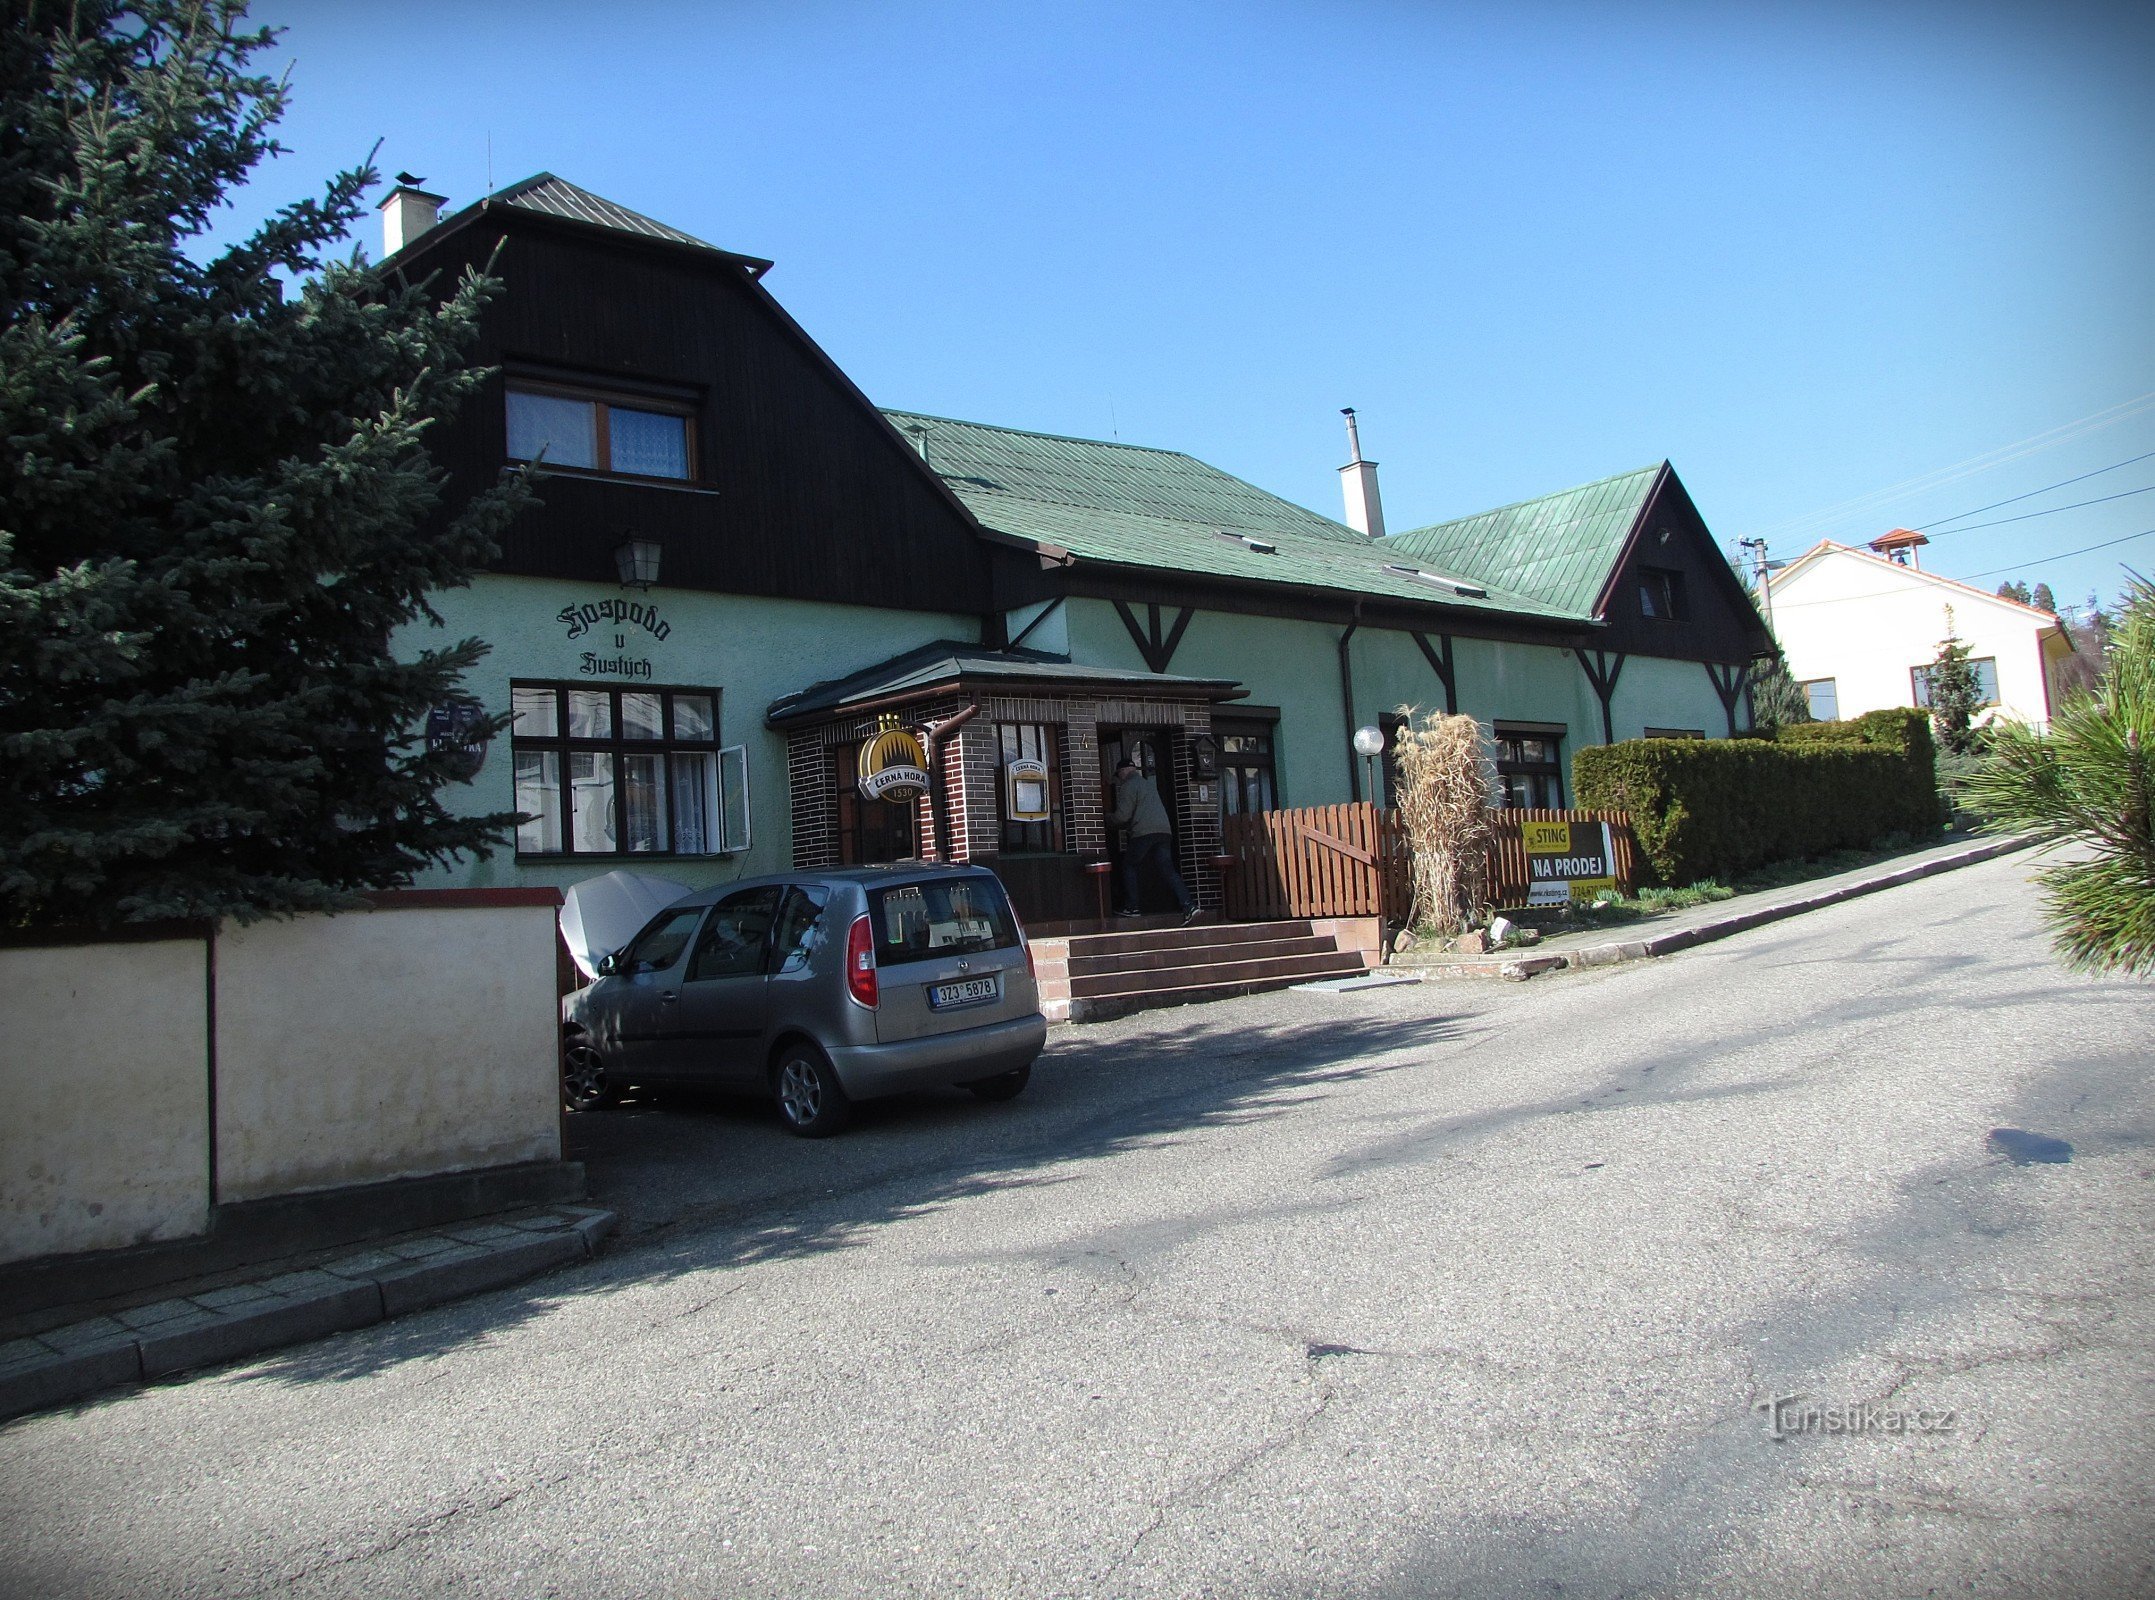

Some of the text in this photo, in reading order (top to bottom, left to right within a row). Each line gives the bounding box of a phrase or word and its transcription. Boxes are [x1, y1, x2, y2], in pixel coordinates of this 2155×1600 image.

[556, 599, 671, 641] Hospoda
[875, 769, 926, 788] ČERNÁ HORA
[893, 788, 912, 797] 1530
[1536, 828, 1567, 843] STING
[1532, 856, 1602, 877] NA PRODEJ
[940, 986, 960, 1001] 3Z3
[965, 980, 991, 996] 5878
